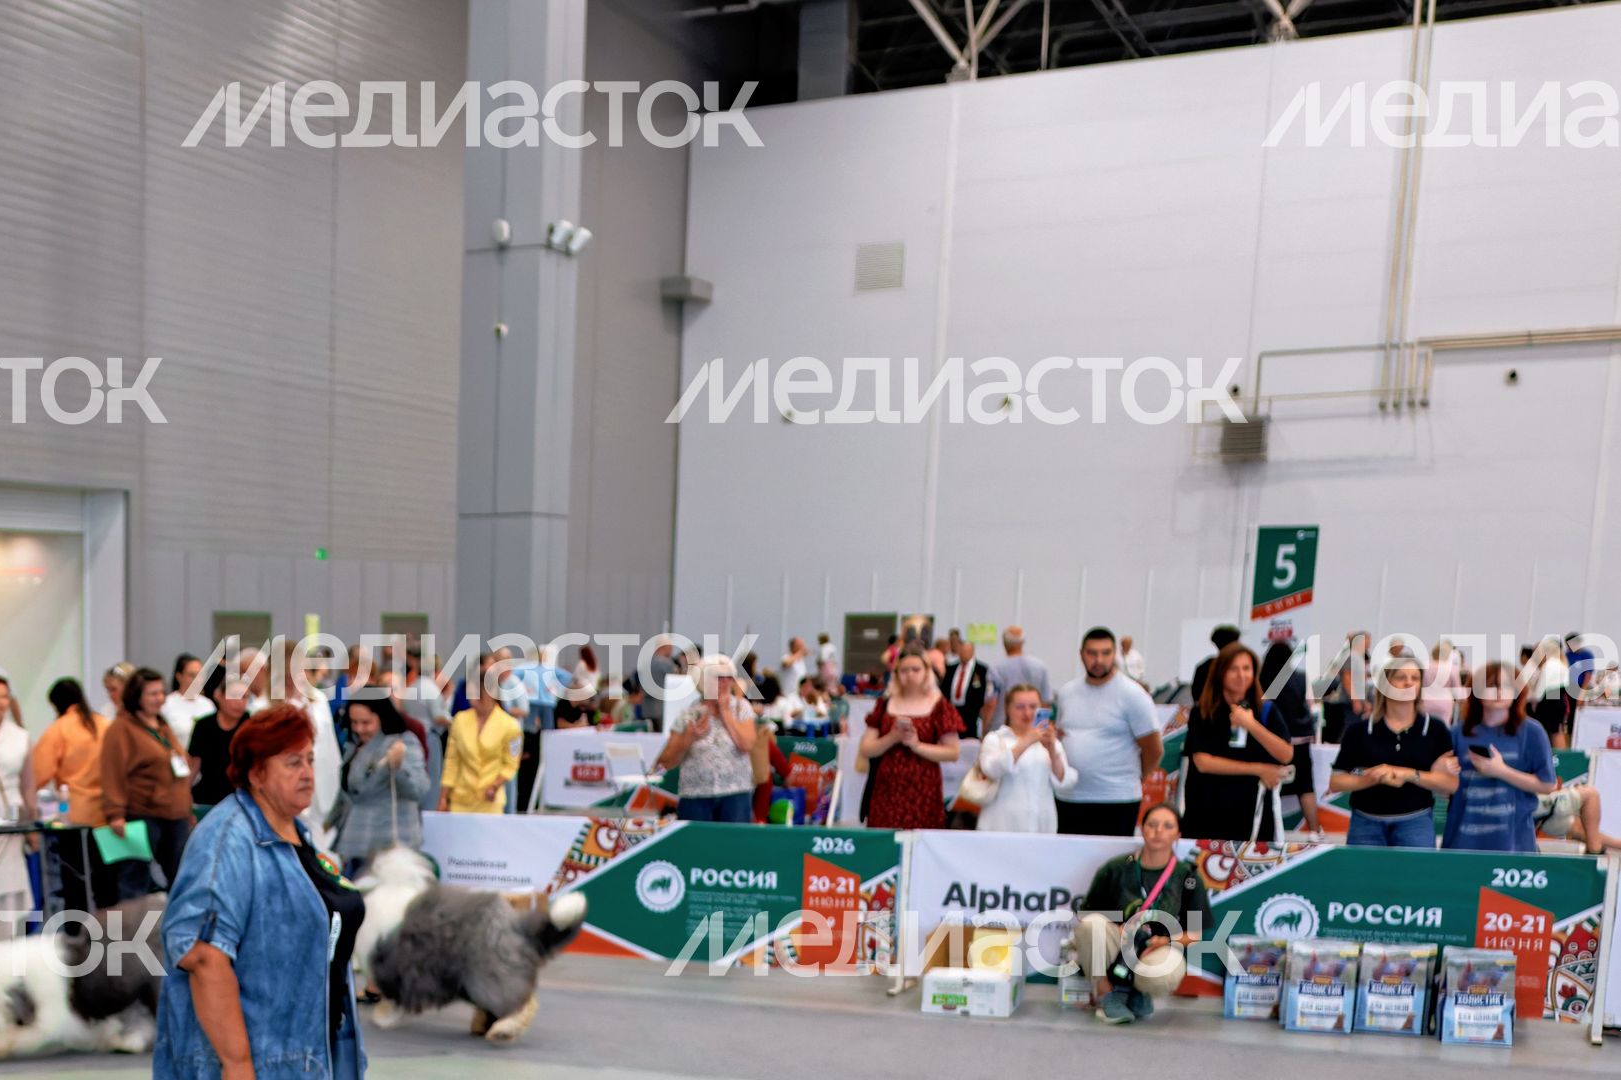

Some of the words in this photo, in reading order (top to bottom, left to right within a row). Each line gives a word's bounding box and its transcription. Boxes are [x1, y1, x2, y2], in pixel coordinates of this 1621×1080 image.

[1272, 543, 1297, 590] 5
[812, 836, 856, 855] 2026
[690, 867, 778, 890] РОССИЯ
[808, 875, 855, 894] 20-21
[1491, 868, 1549, 889] 2026
[942, 881, 1086, 913] AlphaPe
[1328, 901, 1443, 928] РОССИЯ
[1483, 912, 1545, 934] 20-21
[1484, 936, 1543, 951] ИЮНЯ
